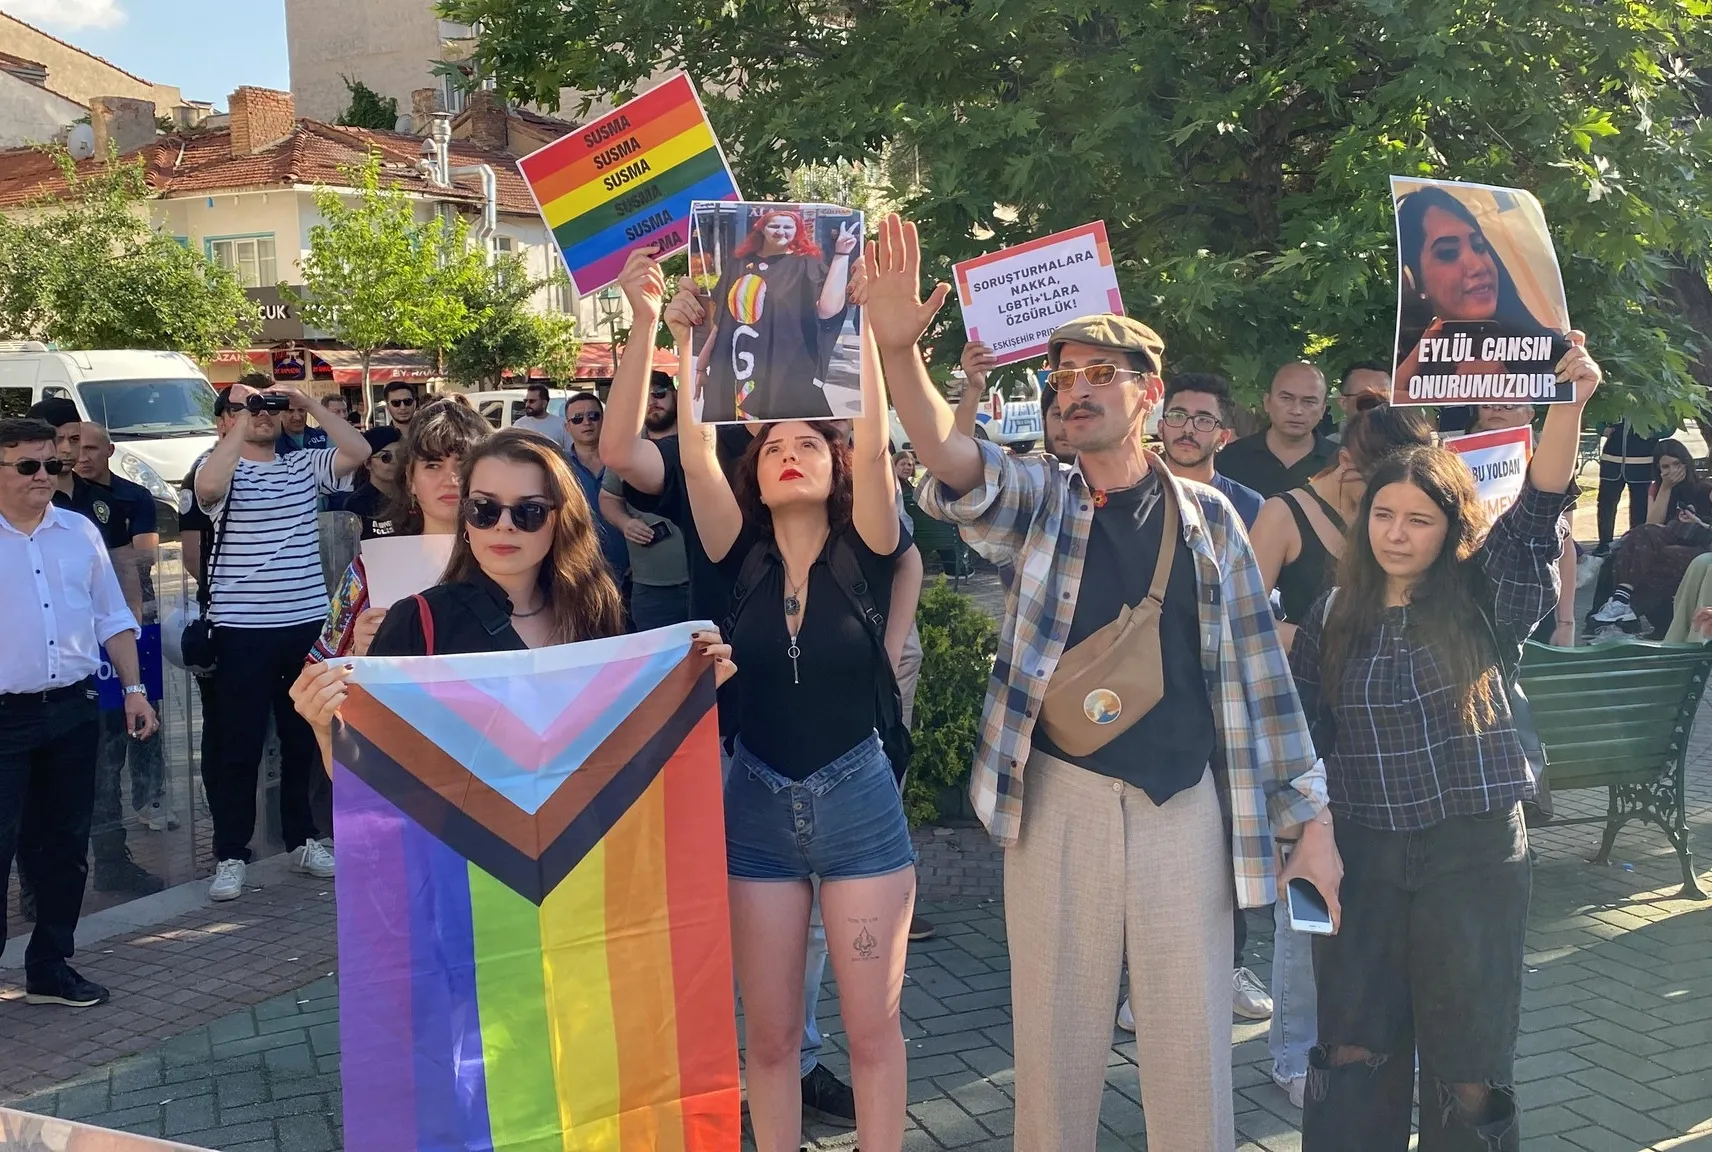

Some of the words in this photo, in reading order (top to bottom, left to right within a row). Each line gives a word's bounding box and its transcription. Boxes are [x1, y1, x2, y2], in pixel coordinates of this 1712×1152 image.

[584, 115, 631, 148] SUSMA
[593, 136, 642, 170] SUSMA
[603, 158, 651, 191] SUSMA
[614, 184, 663, 216] SUSMA
[625, 208, 674, 241] SUSMA
[973, 250, 1094, 293] SORUŞTURMALARA
[1006, 299, 1077, 326] ÖZGÜRLÜK!
[1036, 326, 1060, 340] PRID
[1418, 333, 1475, 363] EYLÜL
[1481, 336, 1552, 362] CANSIN
[1408, 373, 1557, 399] ONURUMUZDUR
[1486, 458, 1521, 480] YOLDAN
